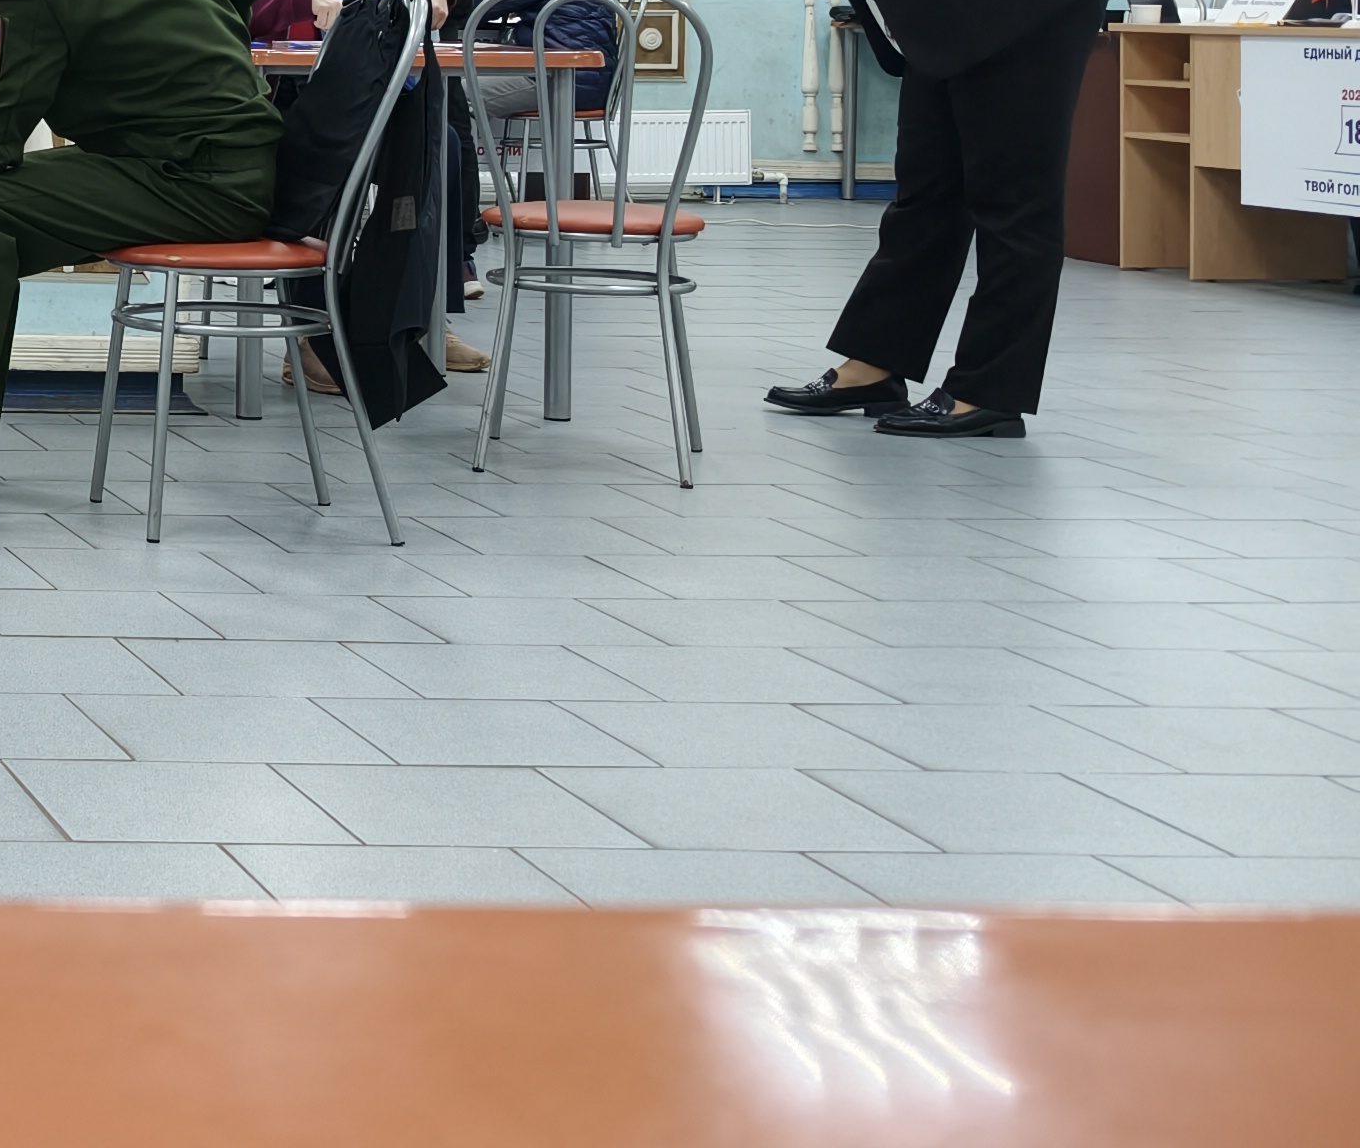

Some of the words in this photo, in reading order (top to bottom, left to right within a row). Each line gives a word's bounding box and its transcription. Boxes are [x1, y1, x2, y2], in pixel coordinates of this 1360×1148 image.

[1303, 45, 1352, 61] ЕДИНЫЙ
[1341, 88, 1360, 101] 202
[1304, 178, 1335, 194] ТВОЙ
[1337, 182, 1360, 197] ГОЛ
